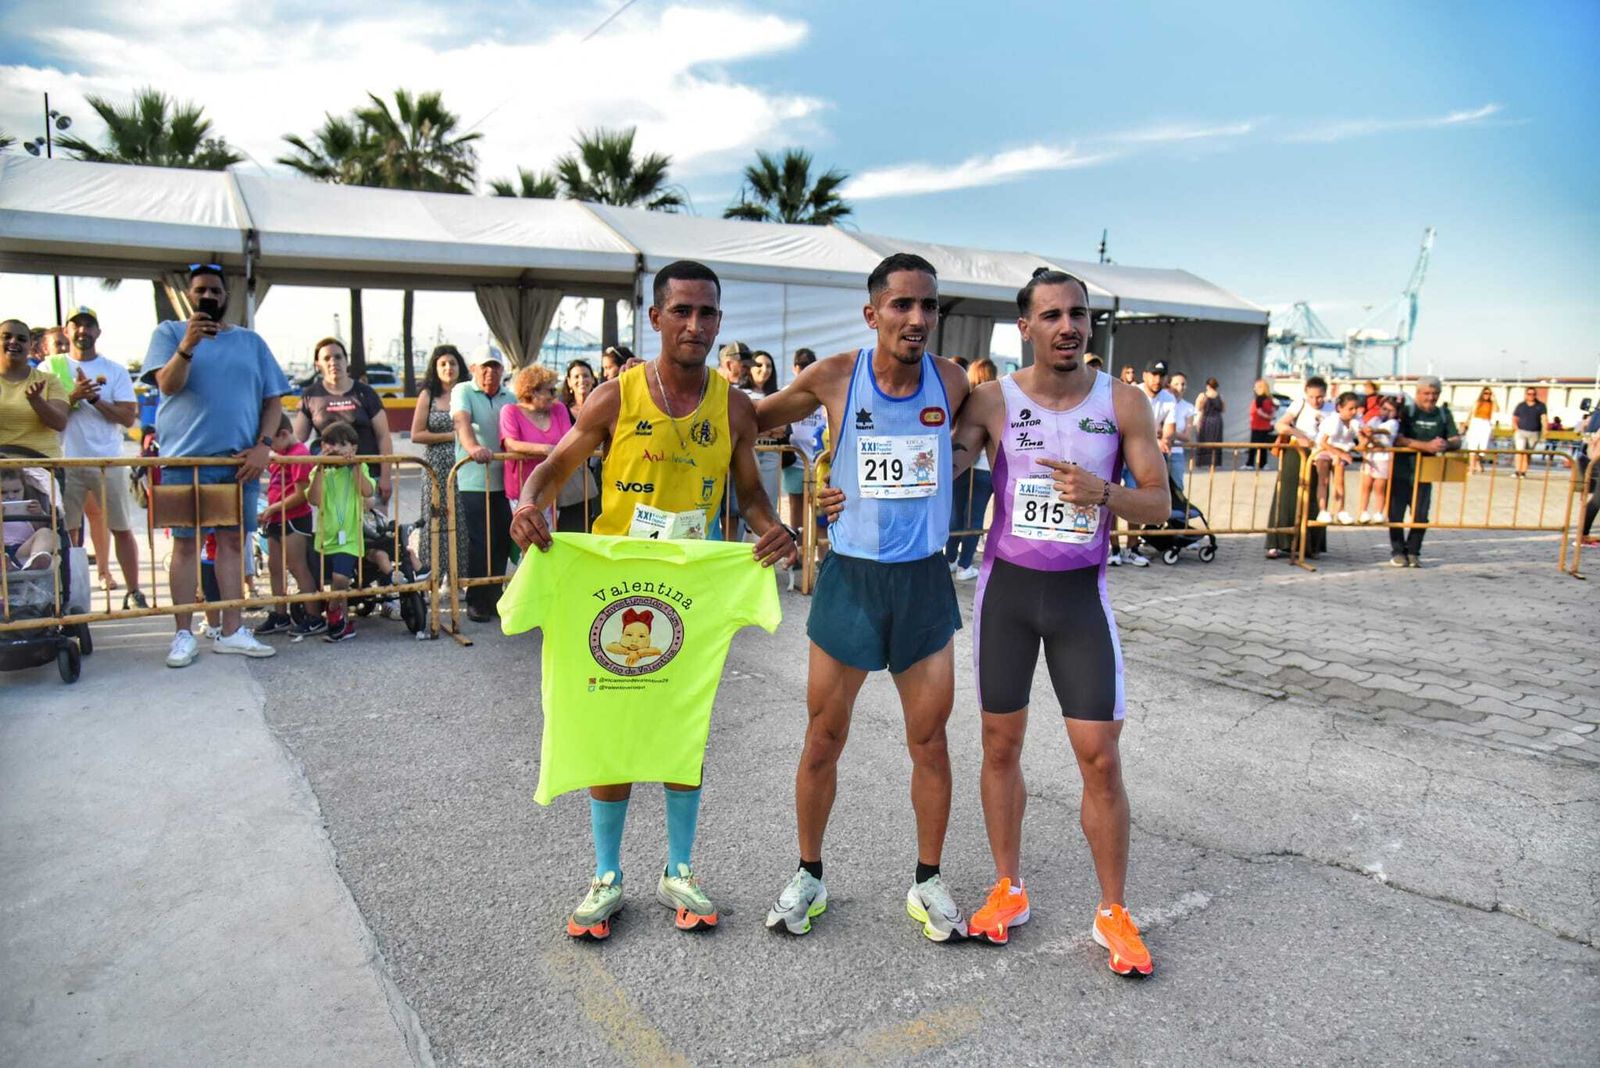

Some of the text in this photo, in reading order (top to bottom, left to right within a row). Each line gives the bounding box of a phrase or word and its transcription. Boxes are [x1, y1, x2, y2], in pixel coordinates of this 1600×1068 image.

[1011, 419, 1041, 428] VIATOR
[861, 441, 876, 452] XXI
[865, 458, 904, 481] 219
[1020, 483, 1034, 493] XXI
[637, 510, 652, 521] XXI
[1024, 500, 1065, 524] 815
[592, 581, 693, 610] Valentina
